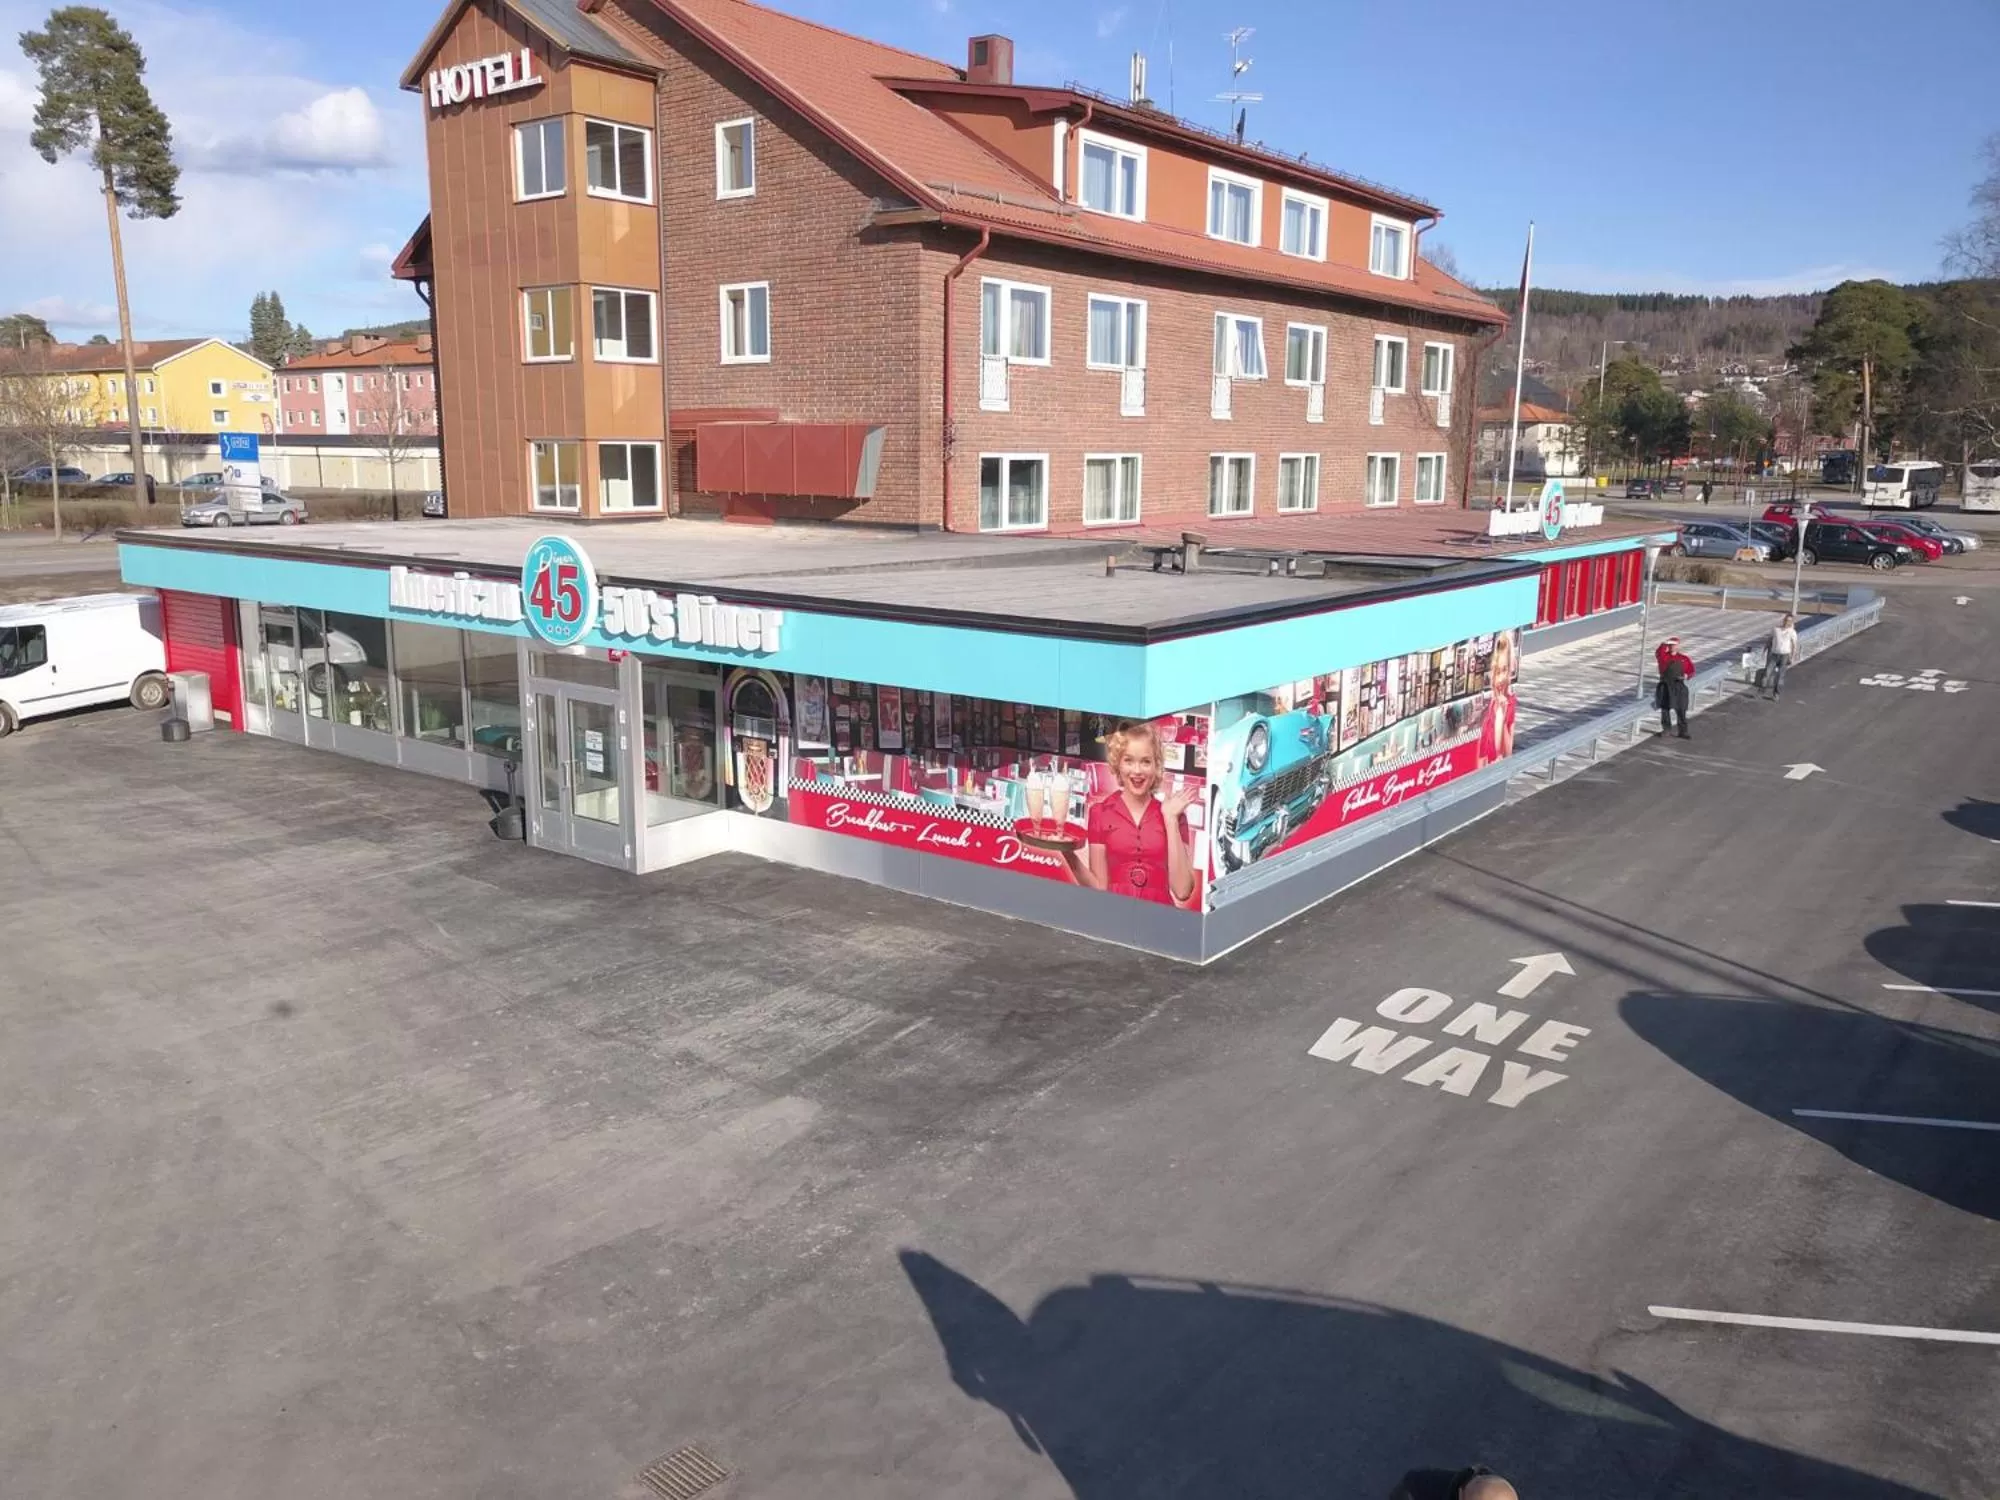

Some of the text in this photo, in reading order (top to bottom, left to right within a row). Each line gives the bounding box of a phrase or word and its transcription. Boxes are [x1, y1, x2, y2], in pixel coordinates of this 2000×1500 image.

[429, 48, 542, 108] HOTELL
[1545, 495, 1561, 526] 45
[533, 544, 573, 573] Diner
[391, 566, 783, 653] American 50's Diner
[530, 564, 582, 622] 45
[825, 803, 1062, 868] Breakfast Lunch Dinner
[1375, 987, 1592, 1062] ONE
[1307, 1017, 1570, 1108] WAY
